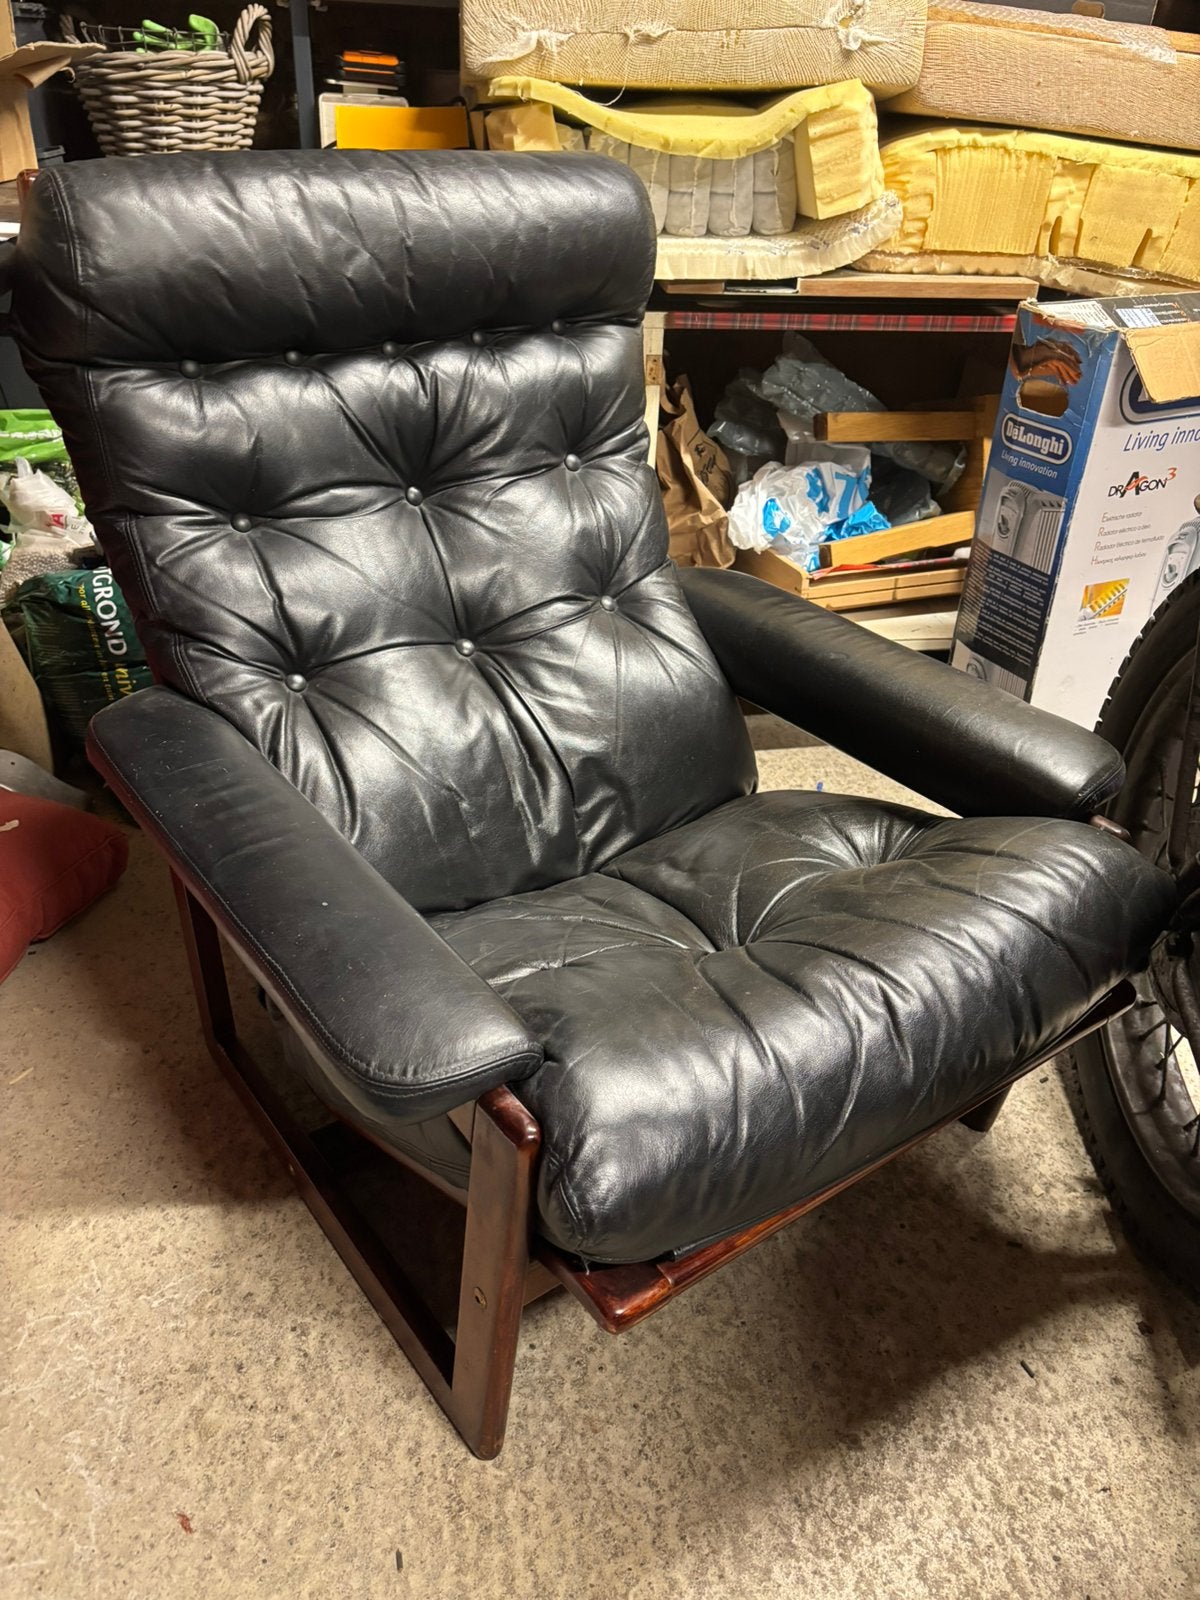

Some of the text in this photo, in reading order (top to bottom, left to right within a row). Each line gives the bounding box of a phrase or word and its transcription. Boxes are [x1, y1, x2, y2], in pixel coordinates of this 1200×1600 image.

[1123, 431, 1169, 452] Living
[1018, 457, 1058, 479] innovation
[92, 566, 128, 656] TGROND
